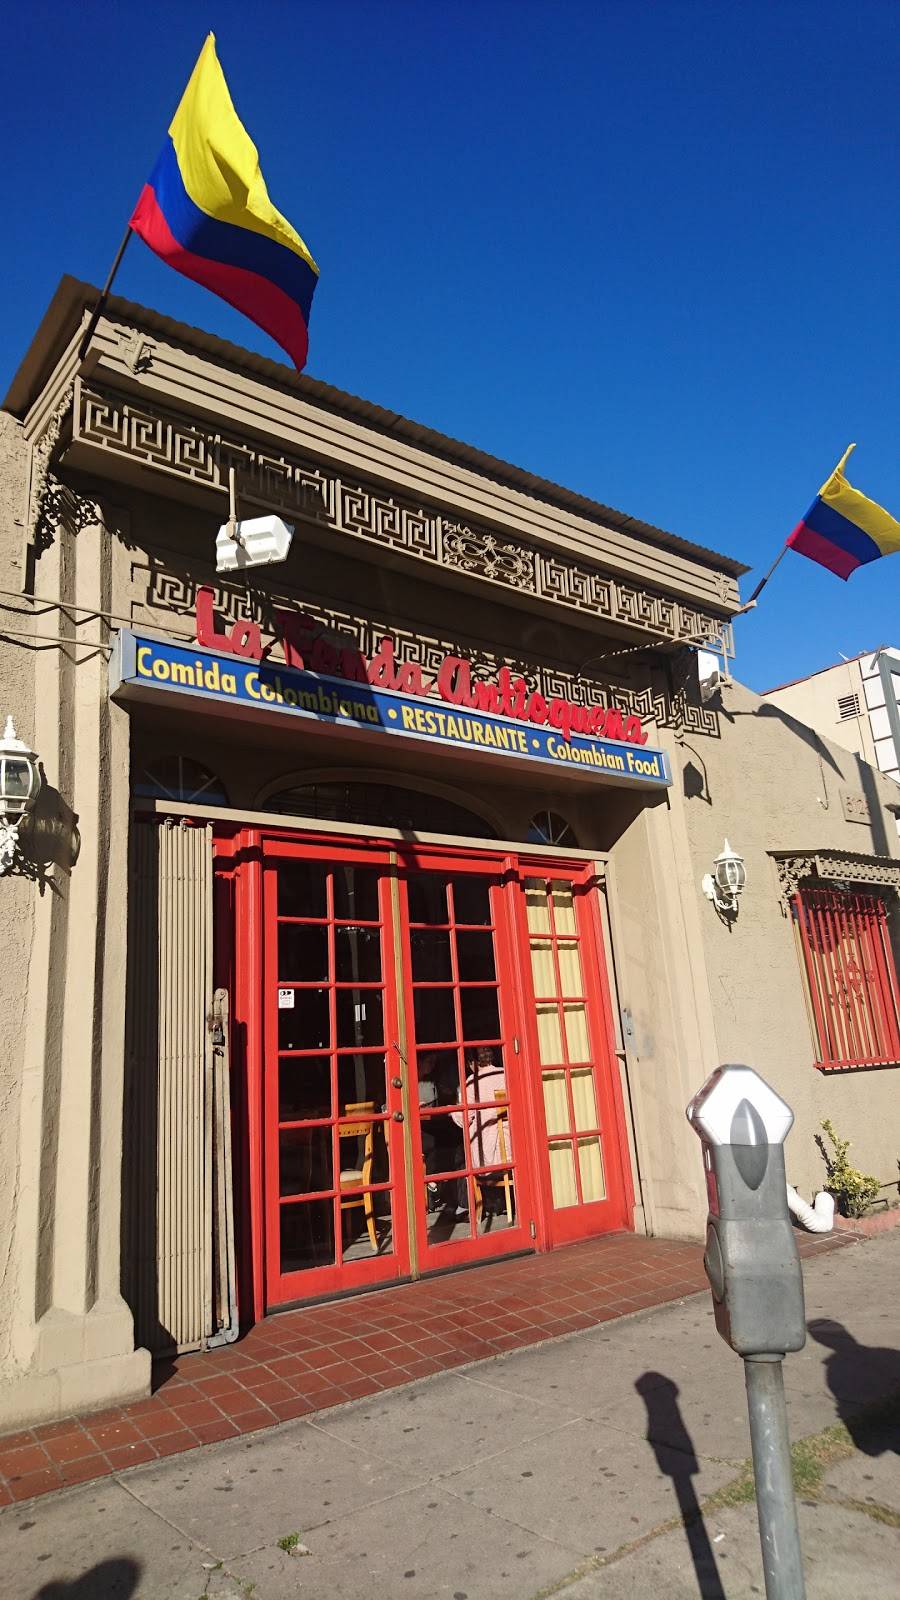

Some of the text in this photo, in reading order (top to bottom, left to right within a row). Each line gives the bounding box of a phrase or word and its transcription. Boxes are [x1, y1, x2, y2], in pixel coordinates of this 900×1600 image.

[196, 585, 270, 660] La
[137, 647, 660, 777] Comida Colombiana RESTAURANTE Colombian Food
